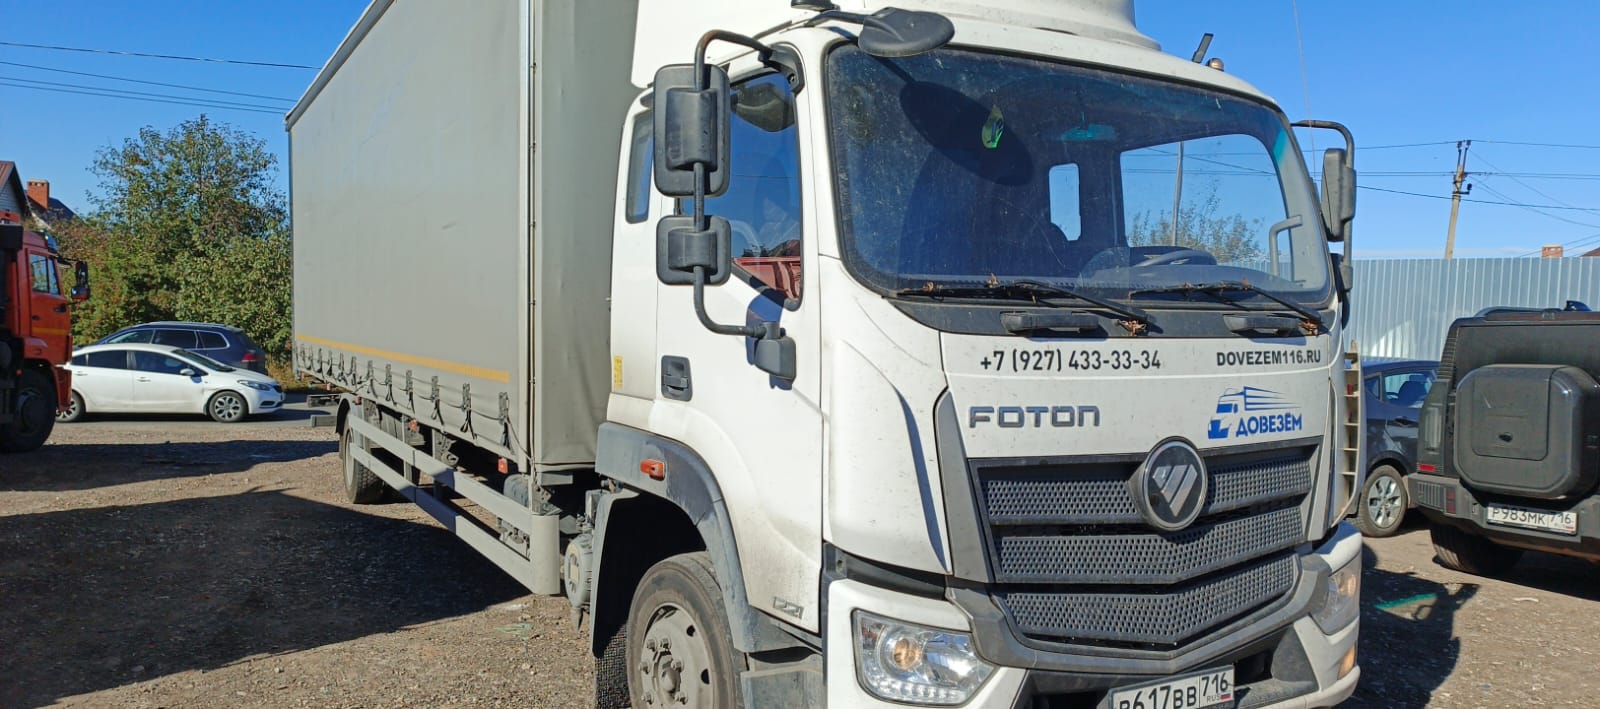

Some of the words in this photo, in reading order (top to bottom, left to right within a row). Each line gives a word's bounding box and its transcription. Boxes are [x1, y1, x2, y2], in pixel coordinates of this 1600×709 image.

[980, 349, 1005, 371] +7
[1012, 348, 1062, 373] (927)
[1068, 349, 1161, 371] 433-33-34
[1216, 349, 1321, 367] DOVEZEM116.RU
[969, 405, 1100, 429] FOTON
[1235, 412, 1303, 438] ДОВЕЗЁМ
[1201, 672, 1229, 697] 716
